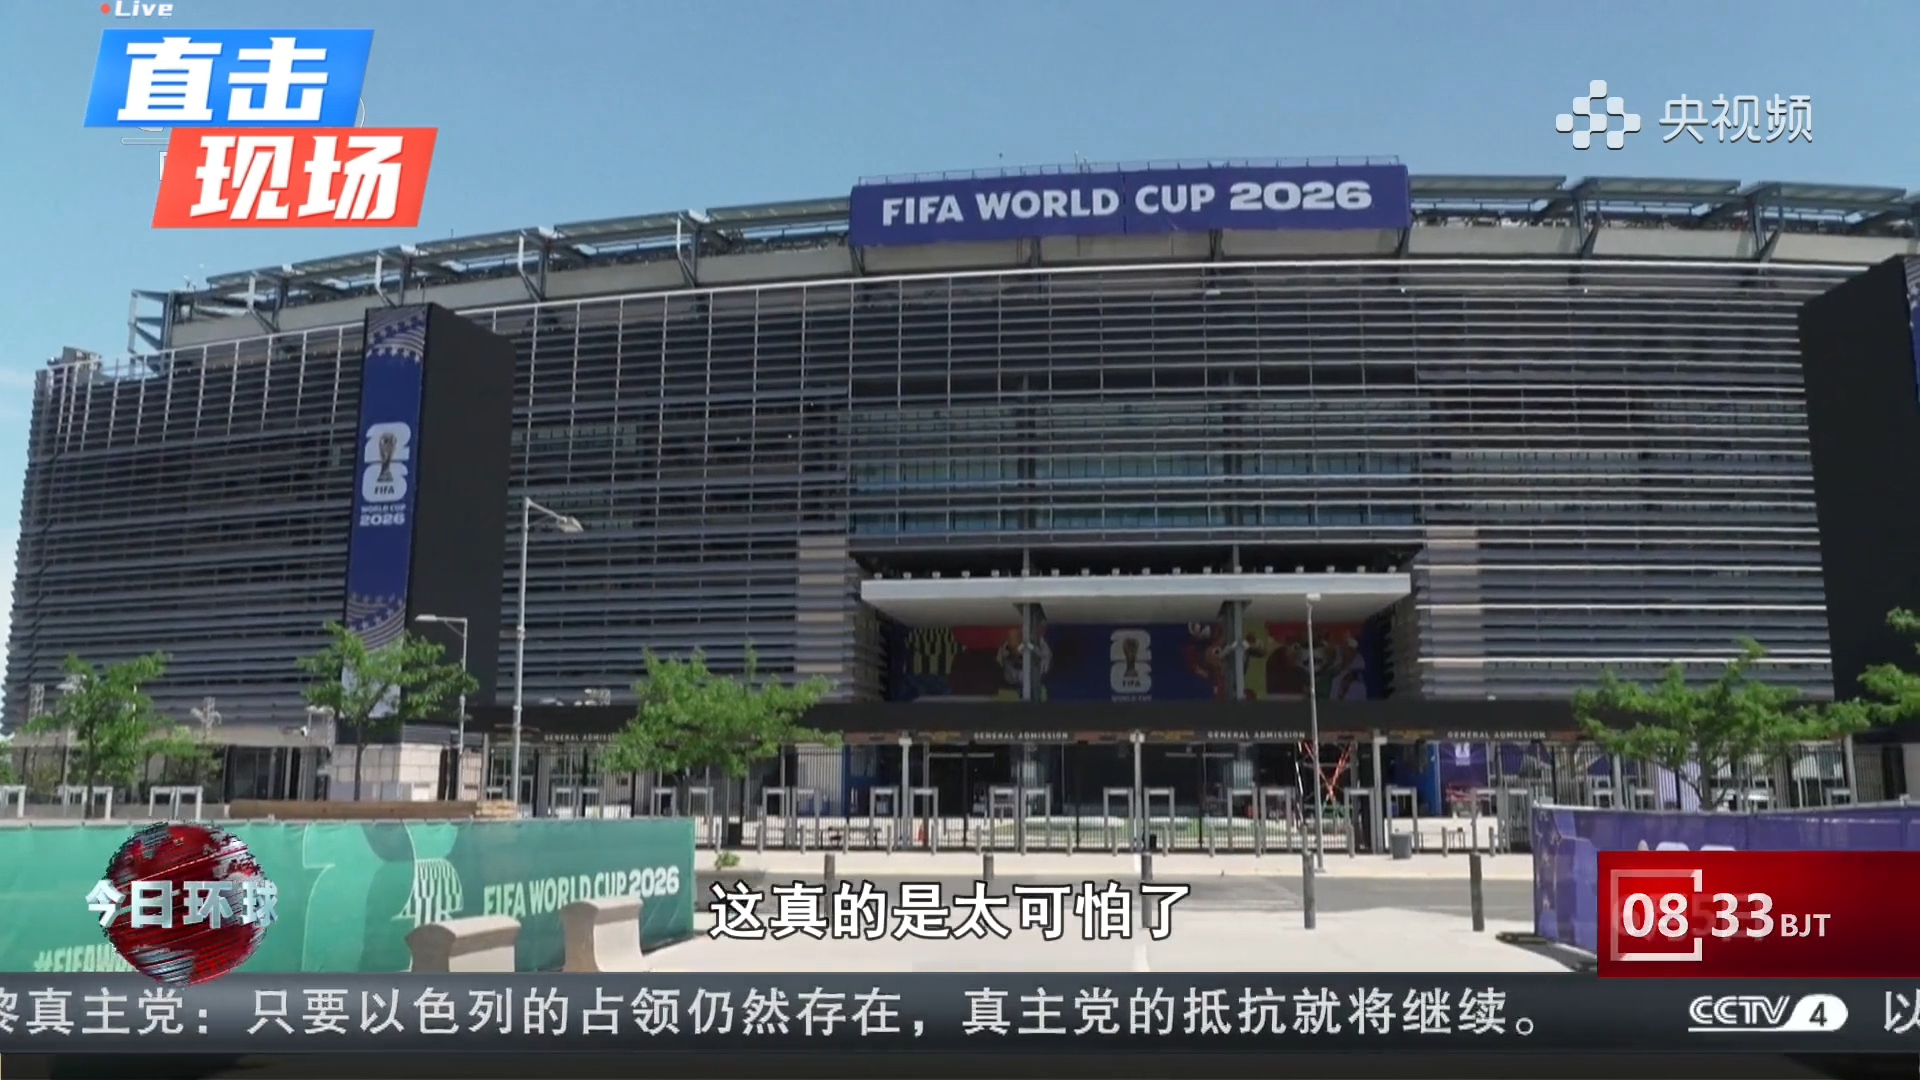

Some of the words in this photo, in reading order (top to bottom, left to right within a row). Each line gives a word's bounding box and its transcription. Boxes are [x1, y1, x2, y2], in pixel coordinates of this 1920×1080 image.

[882, 194, 964, 227] FIFA
[975, 188, 1120, 220] WORLD
[1135, 184, 1215, 214] CUP
[1229, 180, 1374, 211] 2026
[374, 485, 395, 495] FIFA
[360, 513, 405, 526] 2026
[973, 732, 1014, 740] GENERAL
[1018, 731, 1068, 740] ADMISSION
[1207, 731, 1250, 740] GENERAL
[1253, 731, 1306, 740] ADMISSION
[1446, 731, 1490, 739] GENERAL
[1493, 731, 1546, 739] ADMISSION
[483, 881, 526, 918] FIFA
[528, 874, 592, 916] WORLD
[593, 870, 627, 898] CUP
[628, 864, 680, 899] 2026
